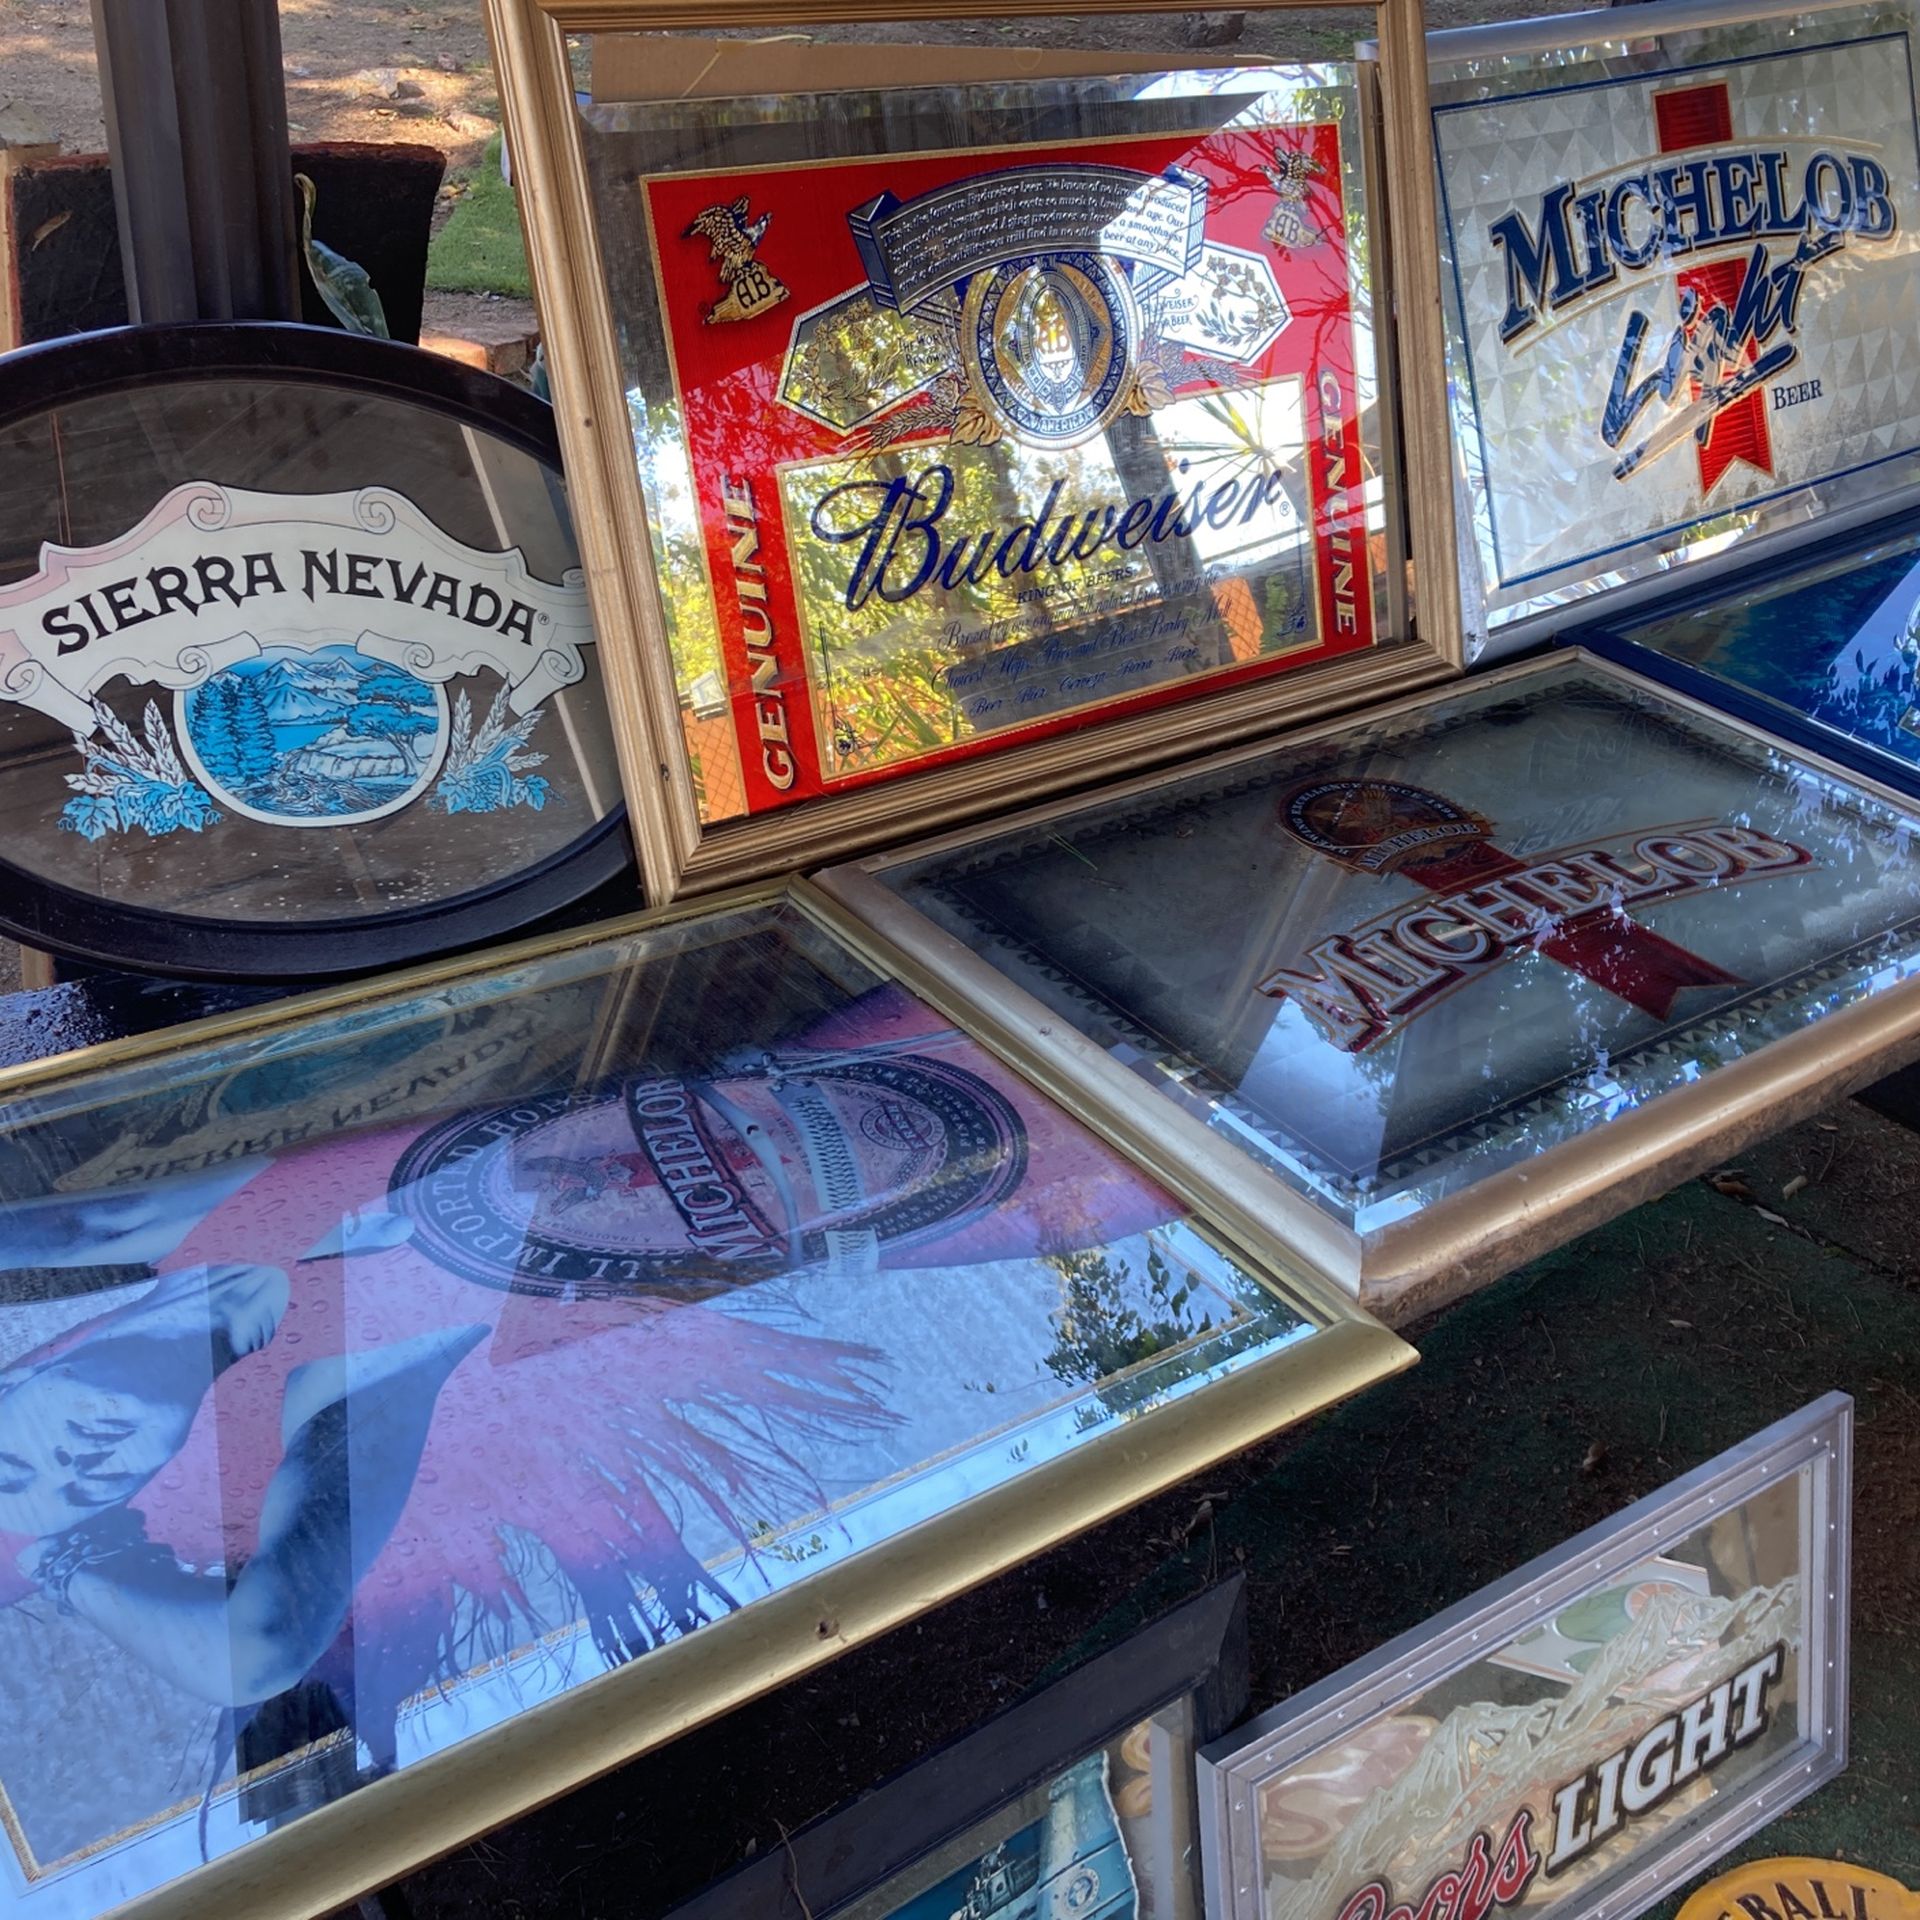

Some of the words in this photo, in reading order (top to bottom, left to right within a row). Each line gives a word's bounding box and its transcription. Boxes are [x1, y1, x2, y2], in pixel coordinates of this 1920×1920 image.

[1489, 150, 1897, 344] MICHELOB
[1601, 234, 1846, 480] Light
[1772, 379, 1823, 411] BEER
[811, 459, 1285, 612] Budweiser
[1320, 370, 1357, 635] GENUINE
[42, 552, 288, 656] SIERRA
[719, 473, 794, 791] GENUINE
[1255, 825, 1812, 1053] MICHELOB
[1358, 823, 1482, 870] MICHELOB
[432, 1142, 568, 1275] IMPORTED
[634, 1077, 788, 1260] MICHELOB
[1547, 1646, 1783, 1873] LIGHT
